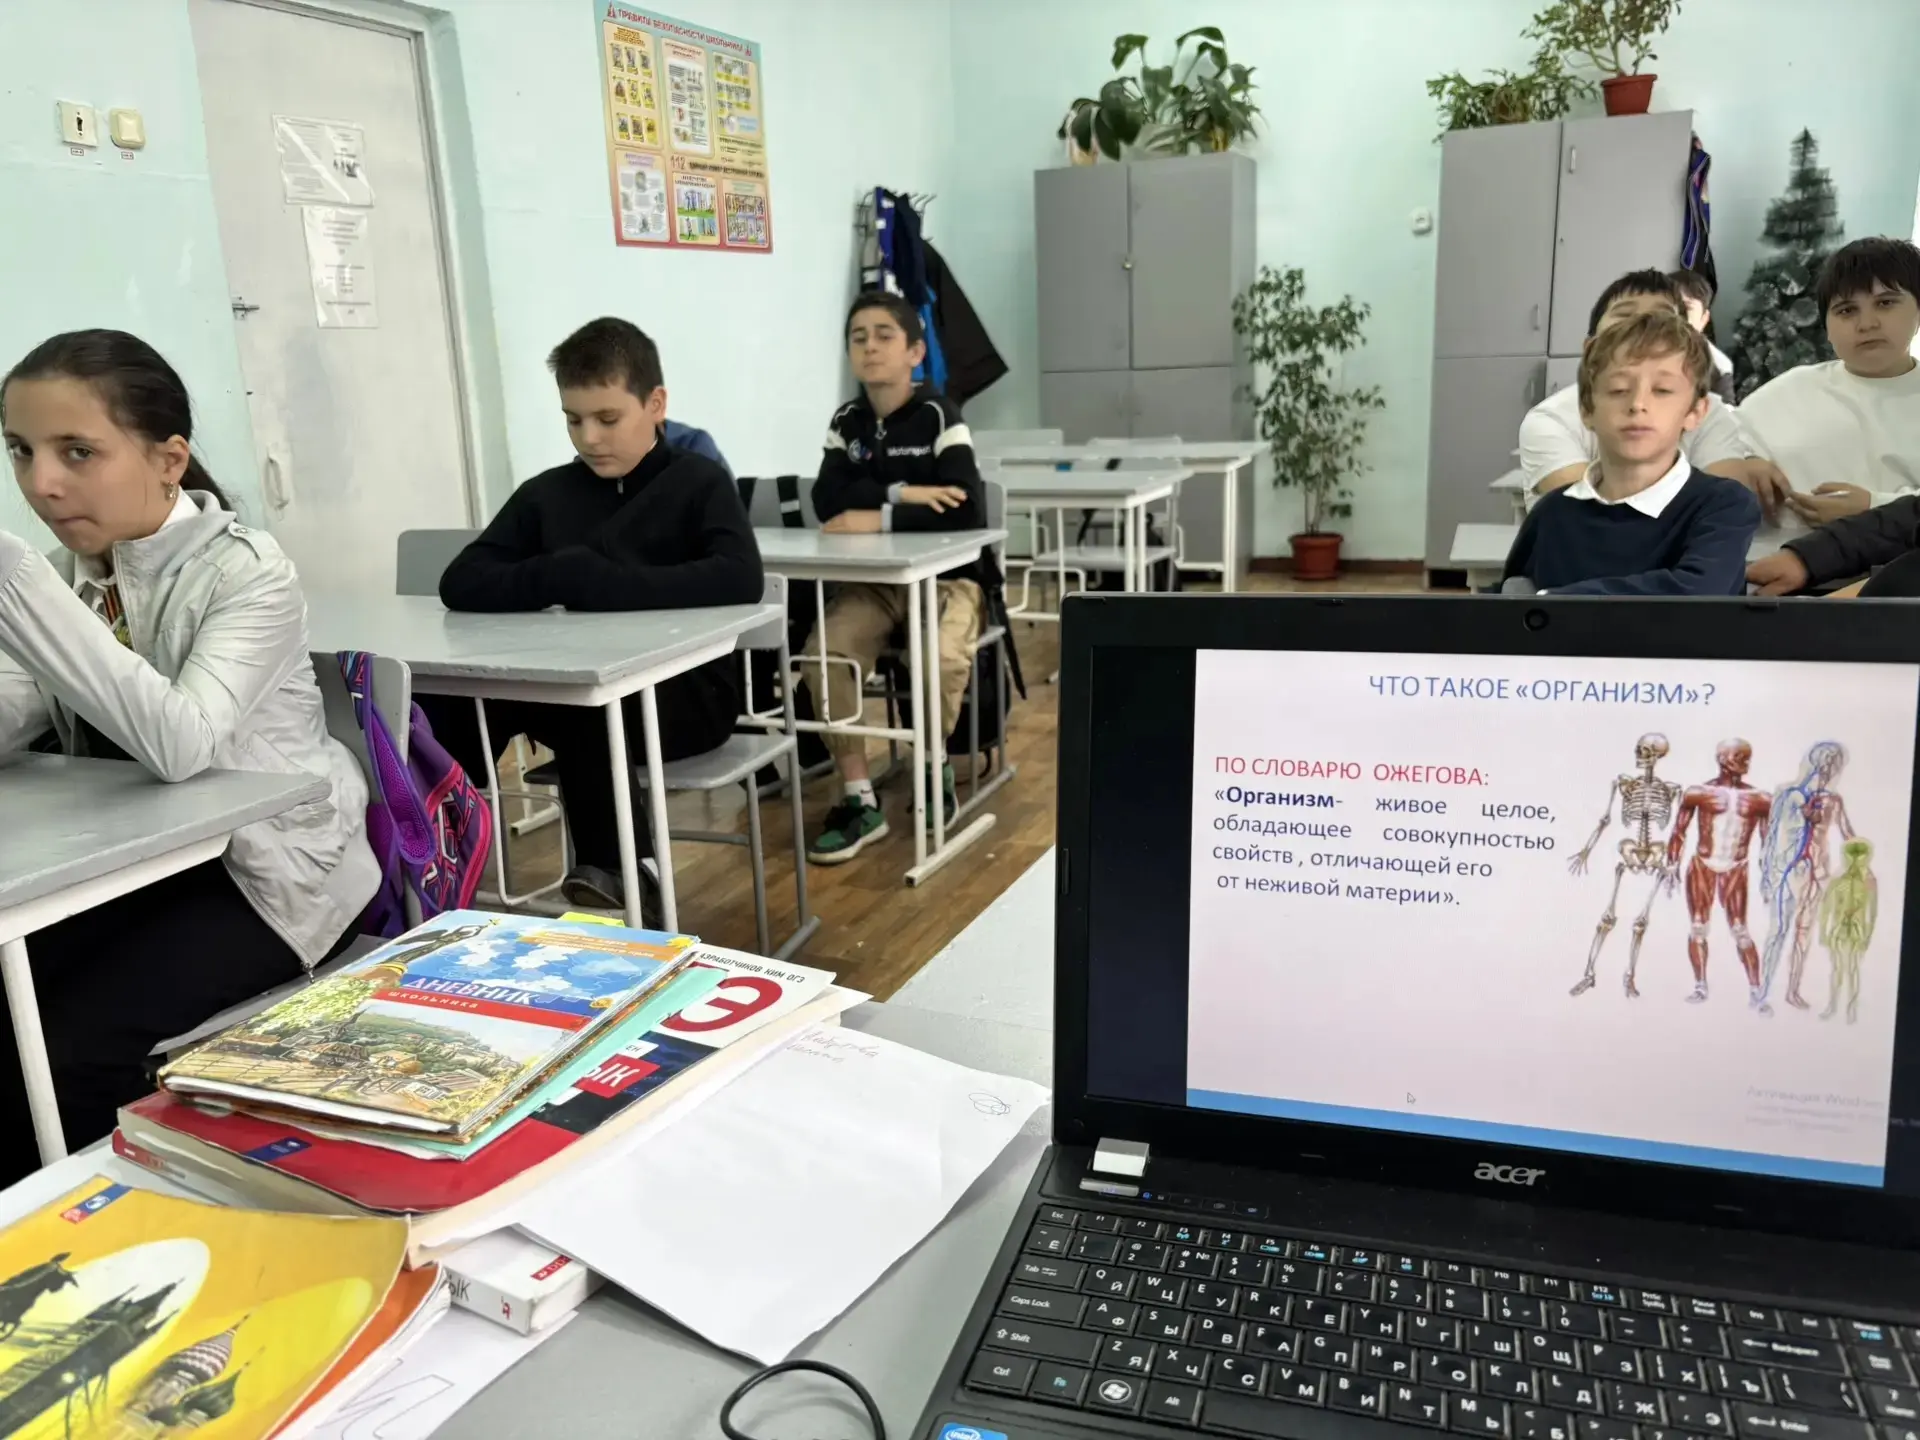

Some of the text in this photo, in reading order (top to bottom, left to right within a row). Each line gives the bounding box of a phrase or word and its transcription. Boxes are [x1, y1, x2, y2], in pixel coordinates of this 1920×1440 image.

[1369, 675, 1716, 706] ЧТО ТАКОЕ «ОРГАНИЗМ»?
[1215, 756, 1489, 786] ПО СЛОВАРЮ ОЖЕГОВА:
[1214, 786, 1556, 824] «Организм- живое целое,
[1213, 813, 1555, 851] обладающее совокупностью
[1310, 852, 1451, 877] отличающей
[1456, 862, 1493, 877] его
[1216, 875, 1460, 906] от неживой материи».
[700, 951, 806, 984] АЗРАБОТЧИКОВ КИМ ОГЭ
[406, 977, 535, 1005] ДНЕВНИК
[388, 990, 479, 1009] школьника
[660, 976, 783, 1032] Э
[587, 1062, 641, 1088] ЫК
[1473, 1162, 1546, 1186] acer
[1051, 1211, 1064, 1219] Esc
[1136, 1220, 1147, 1228] F2
[1131, 1243, 1142, 1251] @
[1265, 1238, 1276, 1246] F5
[1309, 1244, 1320, 1252] F6
[1127, 1252, 1136, 1261] 2
[1181, 1250, 1191, 1258] #
[1195, 1251, 1210, 1260] №
[1178, 1260, 1186, 1268] 3
[1231, 1256, 1238, 1266] $
[1025, 1264, 1040, 1273] Tab
[1229, 1267, 1237, 1276] 4
[1283, 1263, 1295, 1273] %
[1448, 1264, 1460, 1272] F9
[1095, 1269, 1107, 1280] Q
[1281, 1274, 1289, 1283] 5
[1494, 1271, 1510, 1280] F10
[1110, 1281, 1123, 1292] Й
[1147, 1276, 1162, 1287] W
[1334, 1282, 1343, 1291] 6
[1389, 1279, 1399, 1289] &
[1543, 1277, 1558, 1286] F11
[448, 1275, 471, 1302] ЫК
[1197, 1283, 1206, 1294] E
[1161, 1289, 1174, 1302] Ц
[1250, 1291, 1260, 1302] R
[1389, 1290, 1398, 1300] 7
[1415, 1294, 1422, 1303] ?
[1010, 1293, 1051, 1309] Caps Lock
[1216, 1297, 1227, 1307] У
[1305, 1299, 1314, 1310] T
[1445, 1299, 1454, 1309] 8
[1096, 1302, 1108, 1313] A
[1269, 1305, 1281, 1316] К
[1502, 1307, 1512, 1318] 9
[1149, 1310, 1158, 1321] S
[1360, 1308, 1370, 1319] Y
[1111, 1316, 1125, 1326] Ф
[1202, 1318, 1214, 1329] D
[1324, 1314, 1336, 1325] Е
[1416, 1316, 1427, 1327] U
[1560, 1317, 1570, 1327] 0
[1163, 1324, 1179, 1336] Ы
[1257, 1327, 1265, 1337] F
[1379, 1322, 1393, 1334] Н
[1010, 1332, 1031, 1343] Shift
[1221, 1333, 1233, 1344] В
[1314, 1336, 1326, 1347] G
[1439, 1331, 1450, 1342] Г
[1533, 1335, 1547, 1347] O
[1111, 1340, 1123, 1352] Z
[1277, 1341, 1291, 1353] А
[1371, 1345, 1383, 1357] H
[1493, 1340, 1511, 1353] Ш
[1167, 1349, 1178, 1361] X
[1334, 1351, 1348, 1363] П
[1430, 1355, 1438, 1366] J
[1552, 1350, 1572, 1365] Щ
[1128, 1355, 1143, 1367] Я
[1223, 1358, 1234, 1370] C
[1393, 1361, 1406, 1372] Р
[993, 1366, 1011, 1376] Ctrl
[1185, 1364, 1198, 1376] Ч
[1490, 1364, 1501, 1377] K
[1620, 1361, 1633, 1373] З
[1281, 1367, 1293, 1380] V
[1451, 1370, 1467, 1382] О
[1681, 1370, 1696, 1383] Х
[1241, 1374, 1255, 1386] С
[1338, 1377, 1350, 1390] B
[1552, 1374, 1562, 1387] L
[1298, 1383, 1315, 1397] М
[1515, 1381, 1529, 1394] Л
[1399, 1387, 1412, 1401] N
[1576, 1389, 1593, 1405] Д
[1165, 1396, 1181, 1406] Alt
[1360, 1394, 1375, 1407] И
[1460, 1398, 1477, 1412] M
[1423, 1405, 1435, 1418] Т
[1634, 1401, 1655, 1415] Ж
[1485, 1416, 1500, 1429] Ь
[1705, 1412, 1721, 1426] Э
[1550, 1427, 1565, 1440] Б
